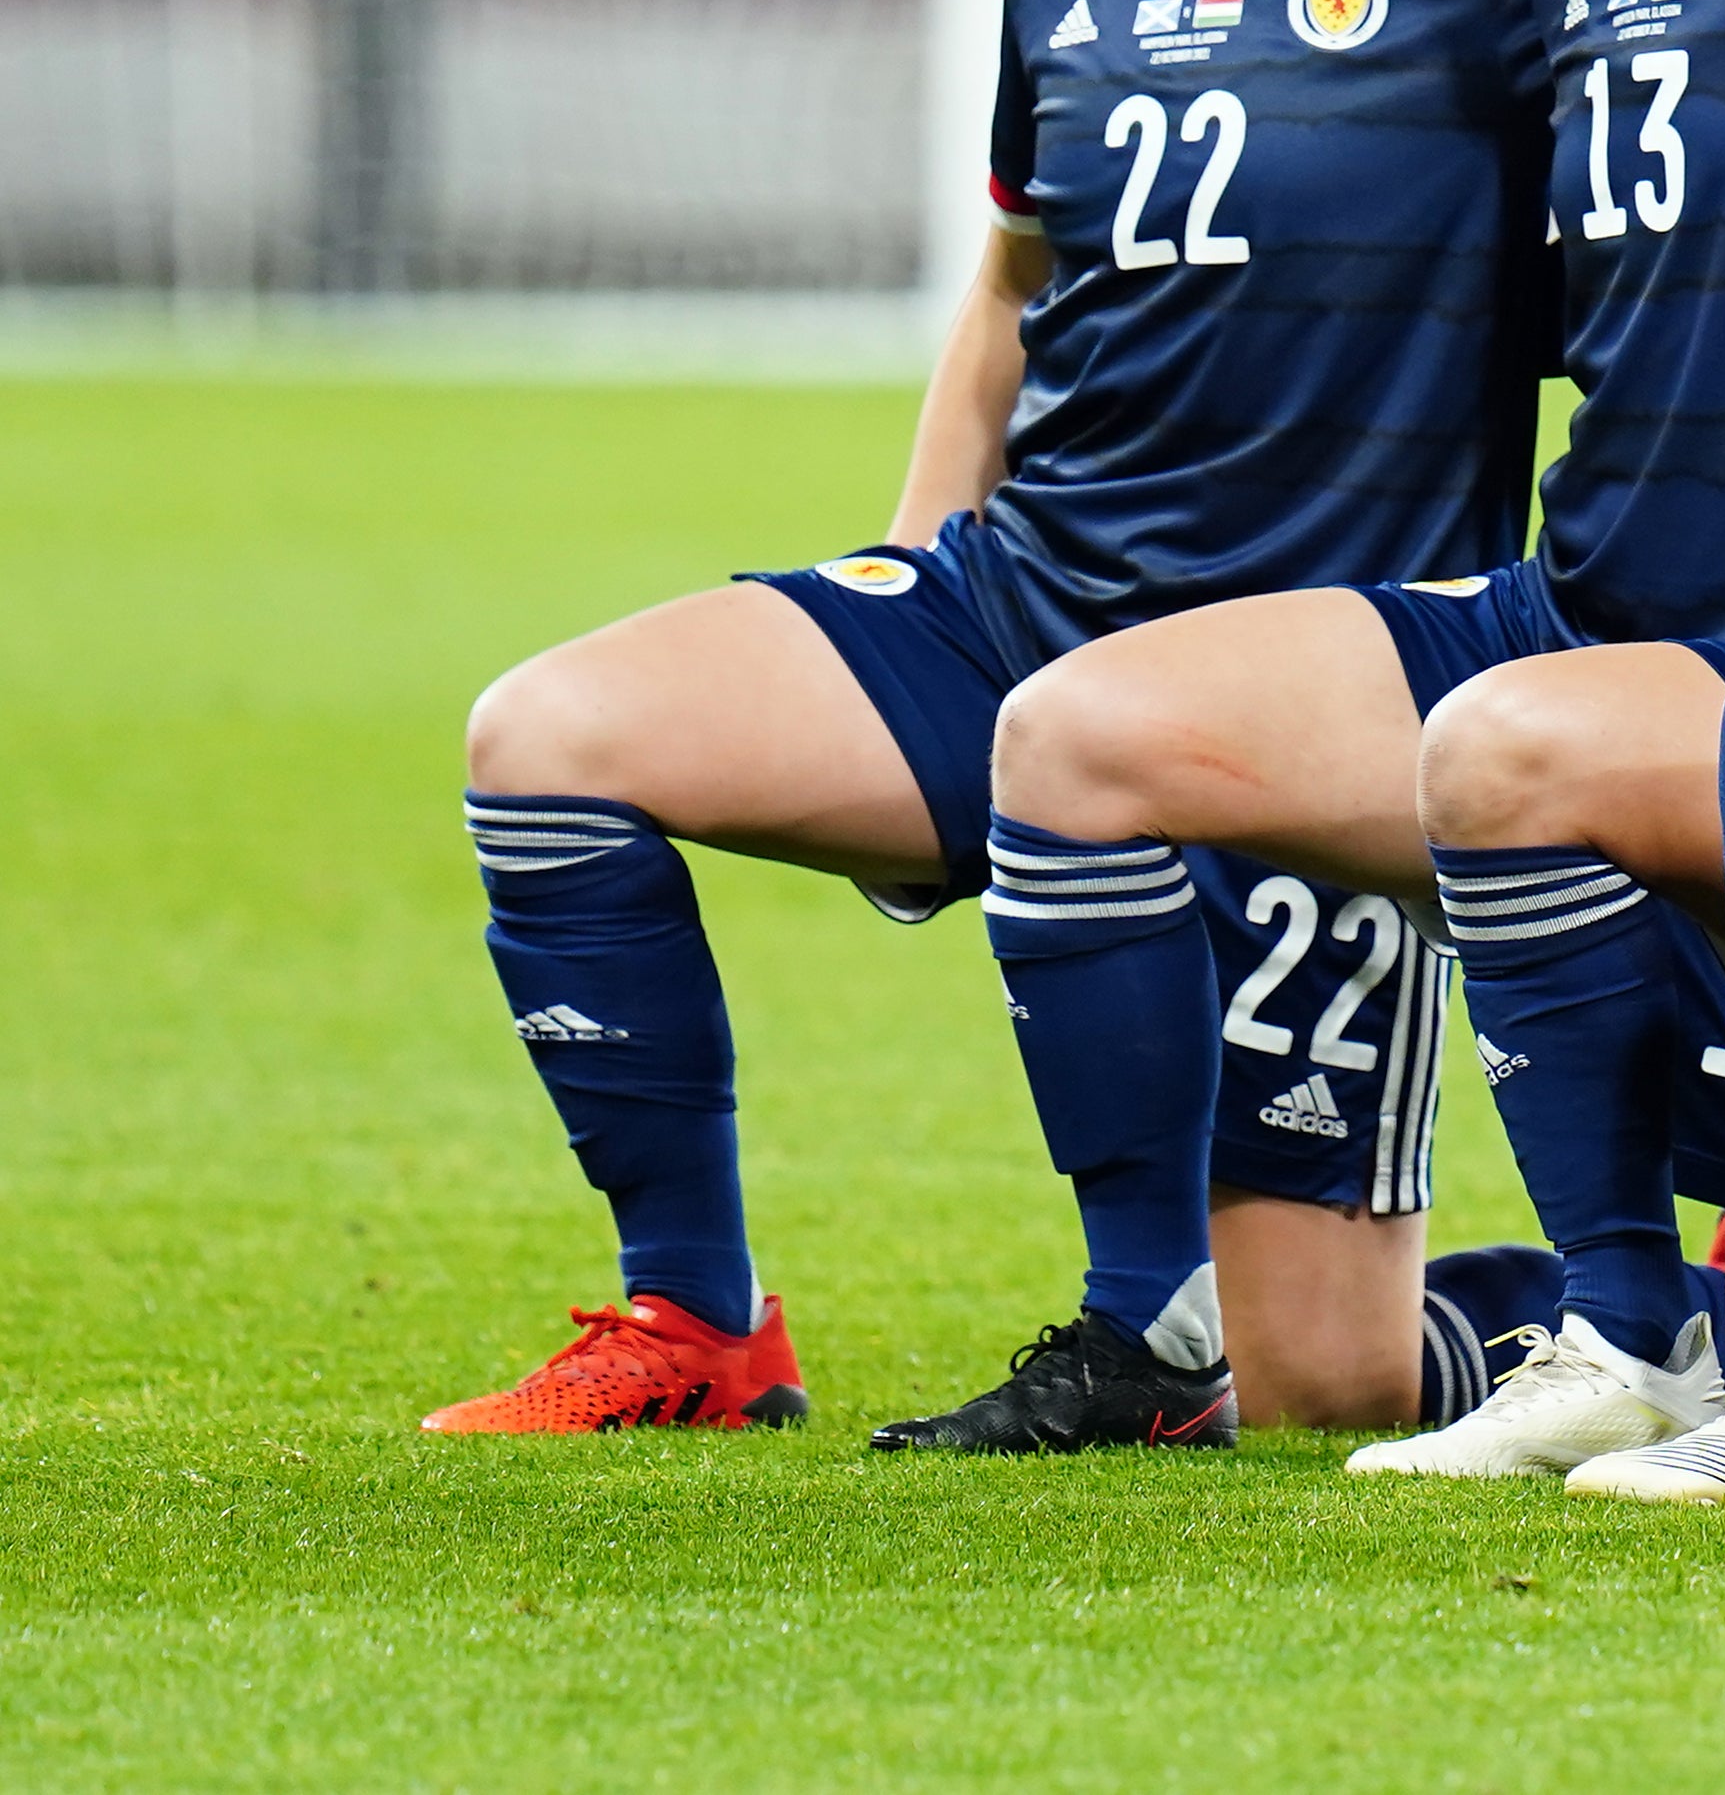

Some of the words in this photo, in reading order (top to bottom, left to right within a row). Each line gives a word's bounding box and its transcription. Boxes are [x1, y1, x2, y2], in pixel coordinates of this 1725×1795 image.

[1104, 89, 1251, 271] 22
[1582, 49, 1689, 240] 13
[1221, 876, 1403, 1073] 22
[1258, 1104, 1350, 1140] adidas
